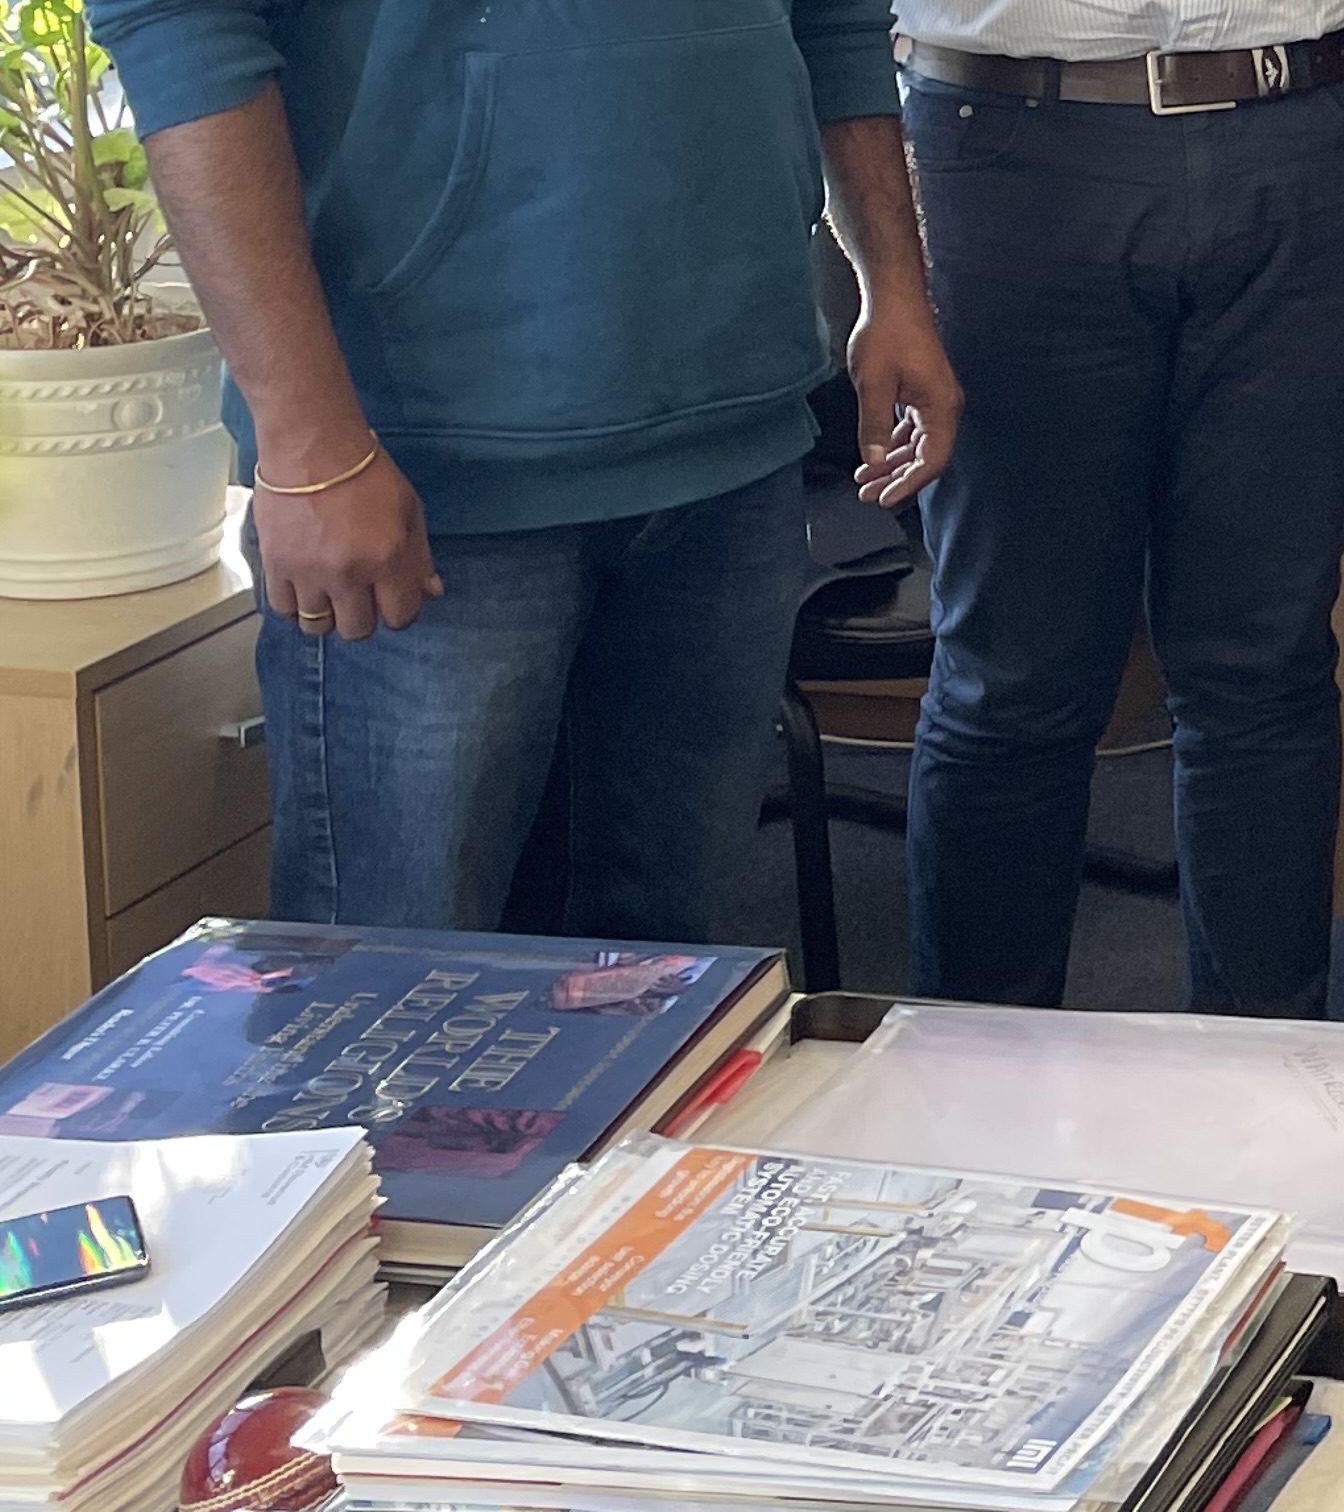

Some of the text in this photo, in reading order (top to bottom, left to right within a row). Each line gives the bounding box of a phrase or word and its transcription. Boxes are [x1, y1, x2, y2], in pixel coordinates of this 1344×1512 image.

[261, 969, 480, 1132] RELIGIONS
[347, 990, 530, 1123] WORLD'S
[448, 1026, 561, 1092] THE
[720, 1162, 784, 1215] SYSTEM
[721, 1165, 807, 1242] AUTOMATIC
[665, 1244, 729, 1294] DOSING
[696, 1196, 800, 1294] ECO-FRIENDLY
[736, 1205, 815, 1281] ACCURATE
